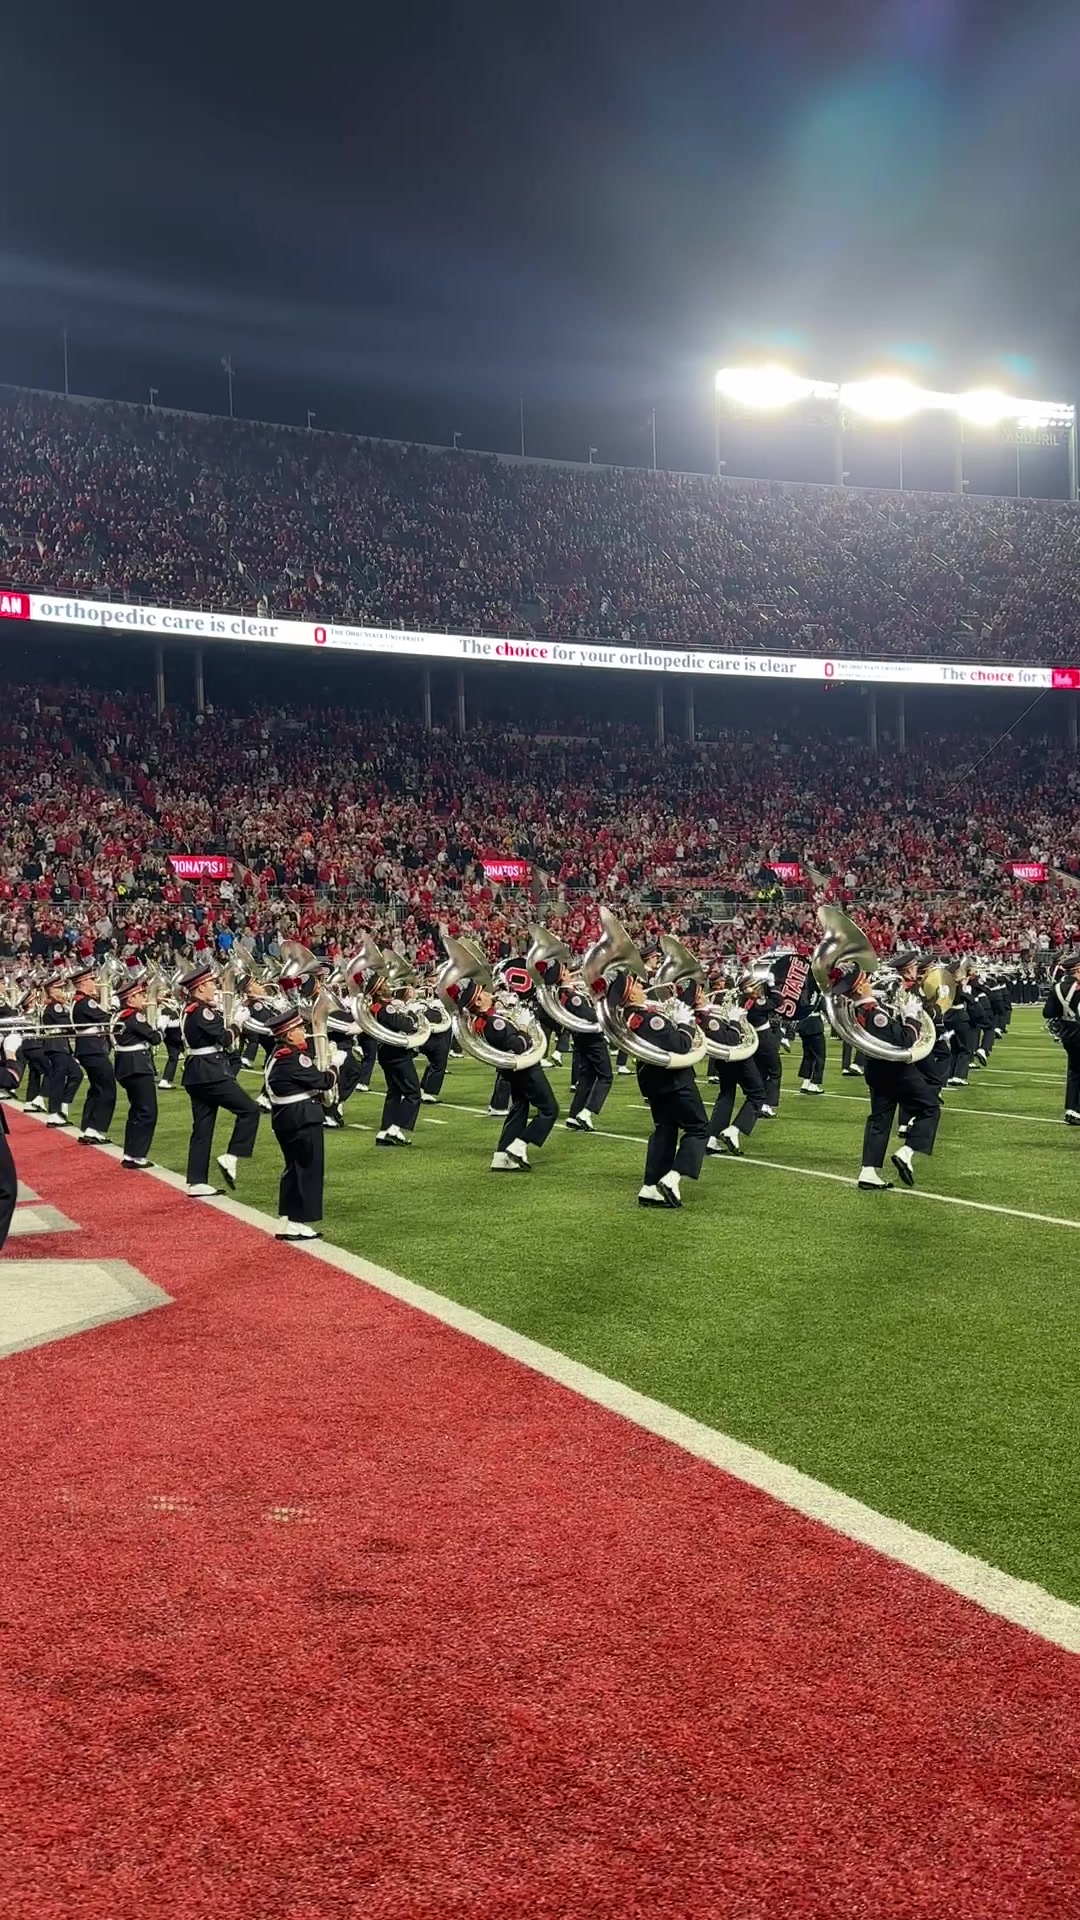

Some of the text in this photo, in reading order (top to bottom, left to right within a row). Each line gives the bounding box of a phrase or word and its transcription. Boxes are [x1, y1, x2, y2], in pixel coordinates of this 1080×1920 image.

[0, 595, 22, 614] AN
[40, 601, 279, 637] orthopedic care is clear
[459, 639, 797, 673] The choice for your orthopedic care is clear
[940, 667, 967, 681] The
[969, 669, 1014, 682] choice
[1018, 669, 1038, 682] for
[484, 865, 519, 876] ONATOS
[775, 956, 810, 1018] STATE
